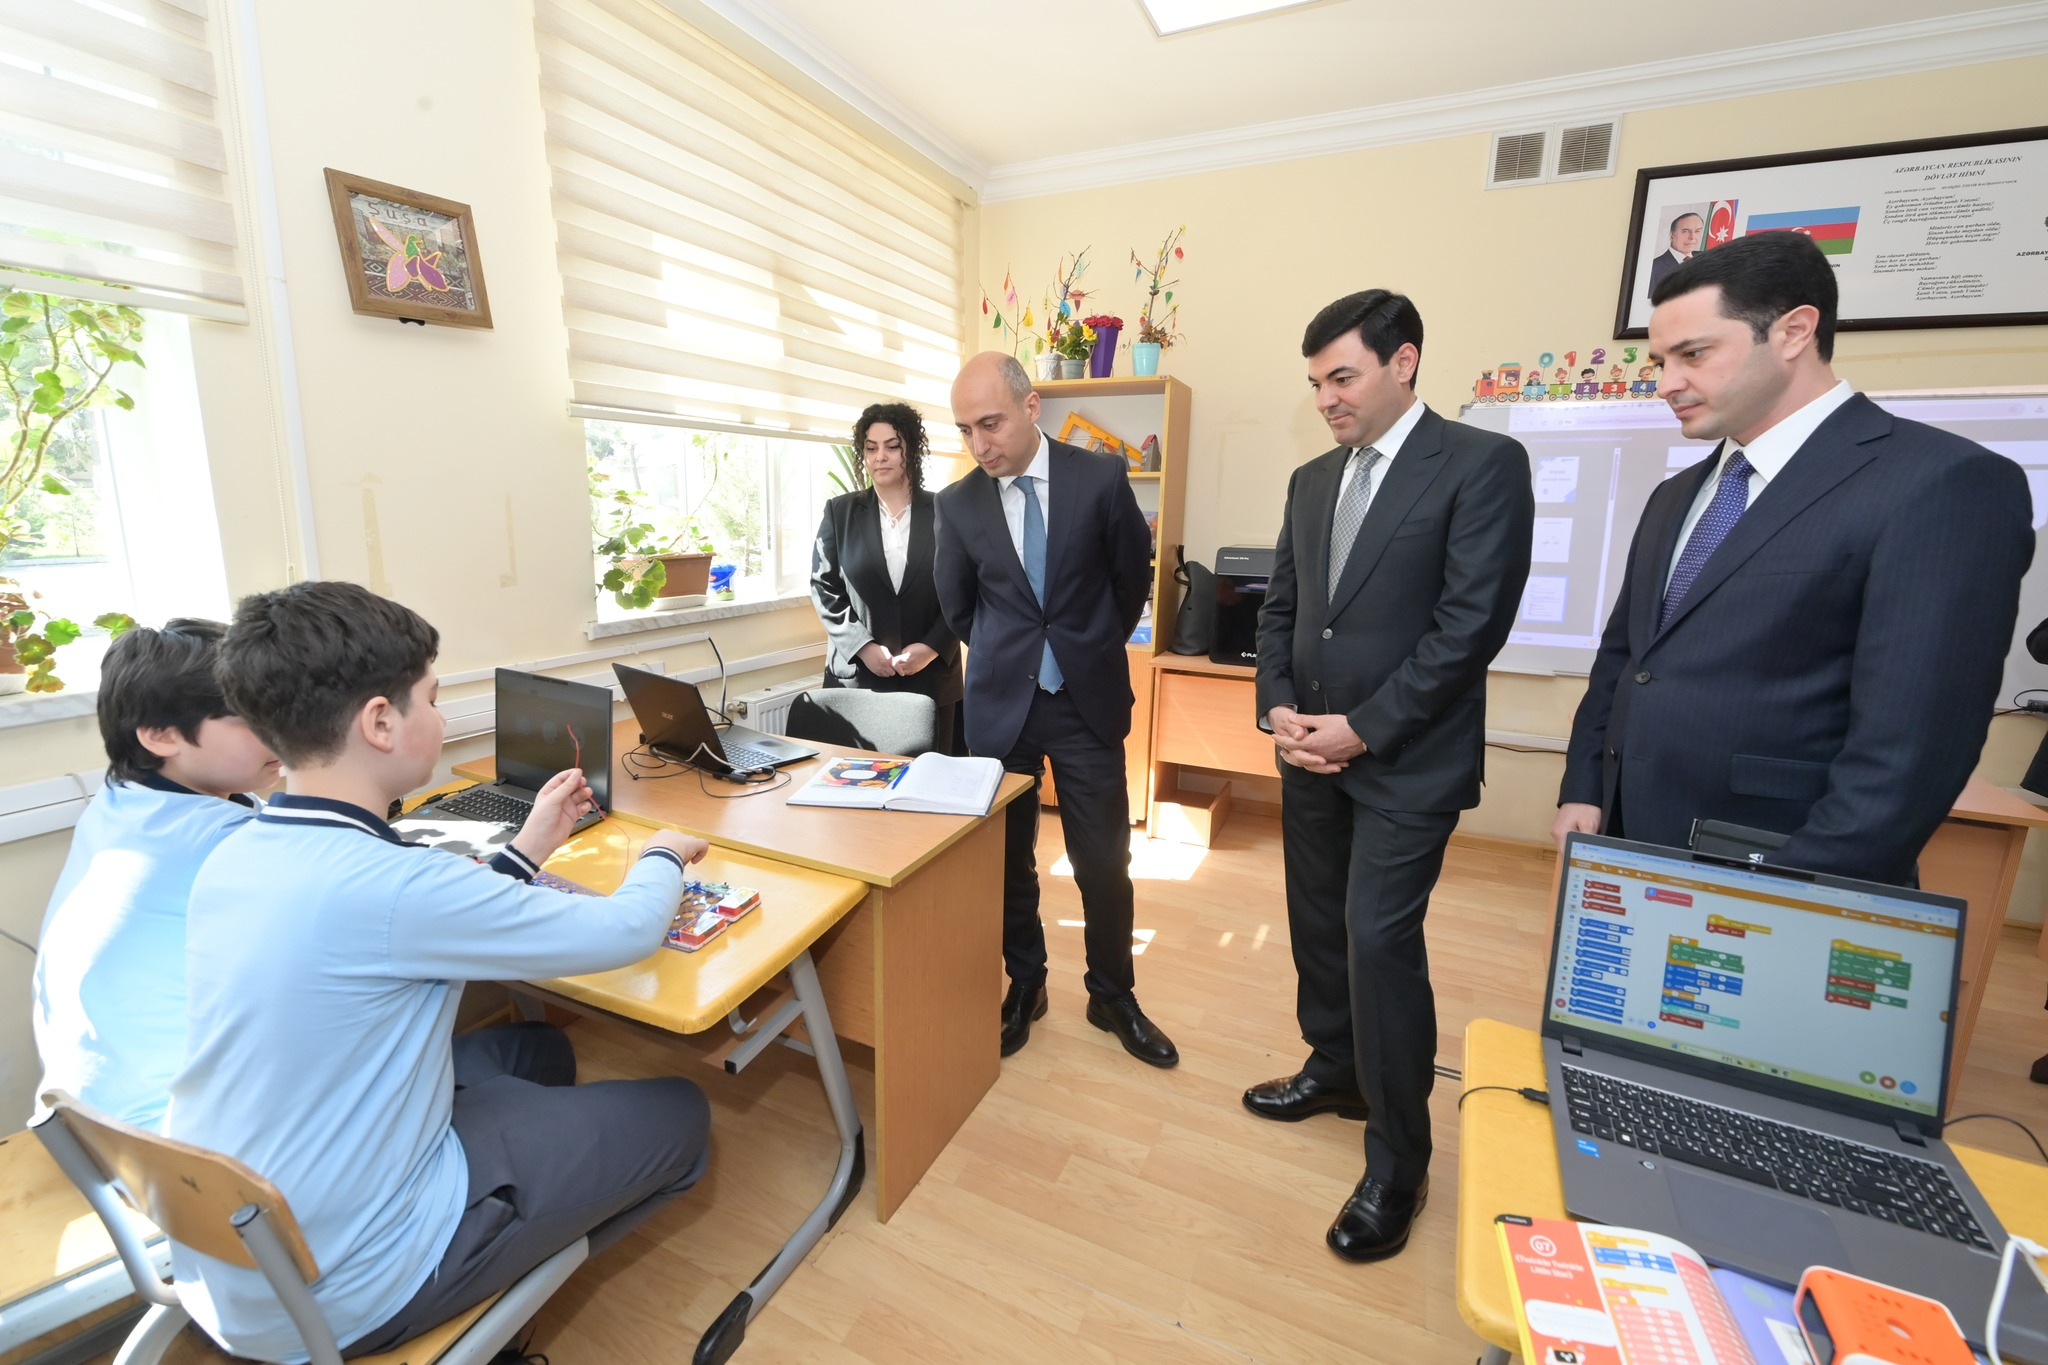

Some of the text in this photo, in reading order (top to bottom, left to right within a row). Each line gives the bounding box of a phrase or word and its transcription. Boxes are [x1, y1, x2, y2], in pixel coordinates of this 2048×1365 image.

[1893, 156, 2022, 174] AZƏRBAYCAN RESPUBLİKASININ
[1924, 169, 1985, 181] DÖVLƏT HİMNİ
[1564, 351, 1577, 367] 1
[1590, 348, 1606, 365] 2
[1622, 347, 1638, 364] 3
